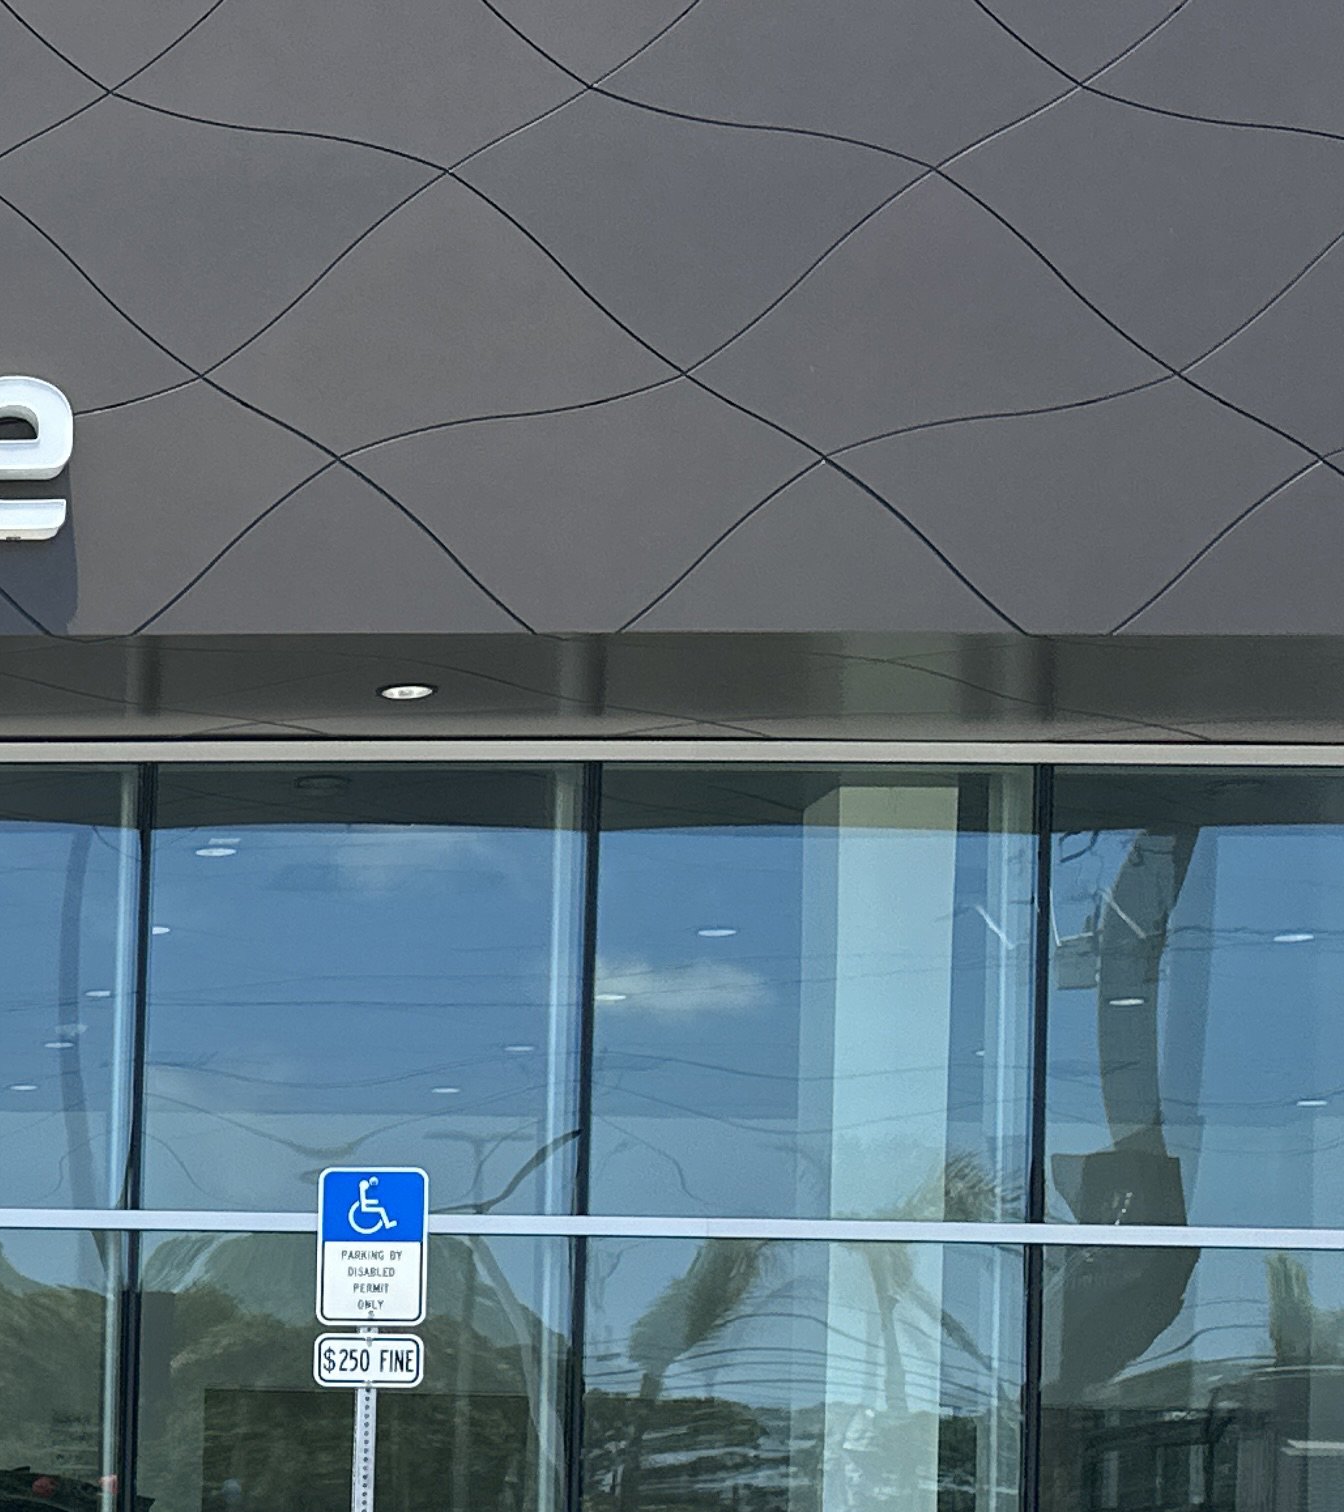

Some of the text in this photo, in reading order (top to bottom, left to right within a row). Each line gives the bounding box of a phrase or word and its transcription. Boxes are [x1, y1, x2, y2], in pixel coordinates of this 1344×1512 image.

[341, 1250, 403, 1261] PARKING BY
[347, 1266, 396, 1277] DISABLED
[353, 1283, 389, 1294] PERMIT
[357, 1299, 385, 1310] ONLY
[323, 1345, 414, 1374] $250 FINE
